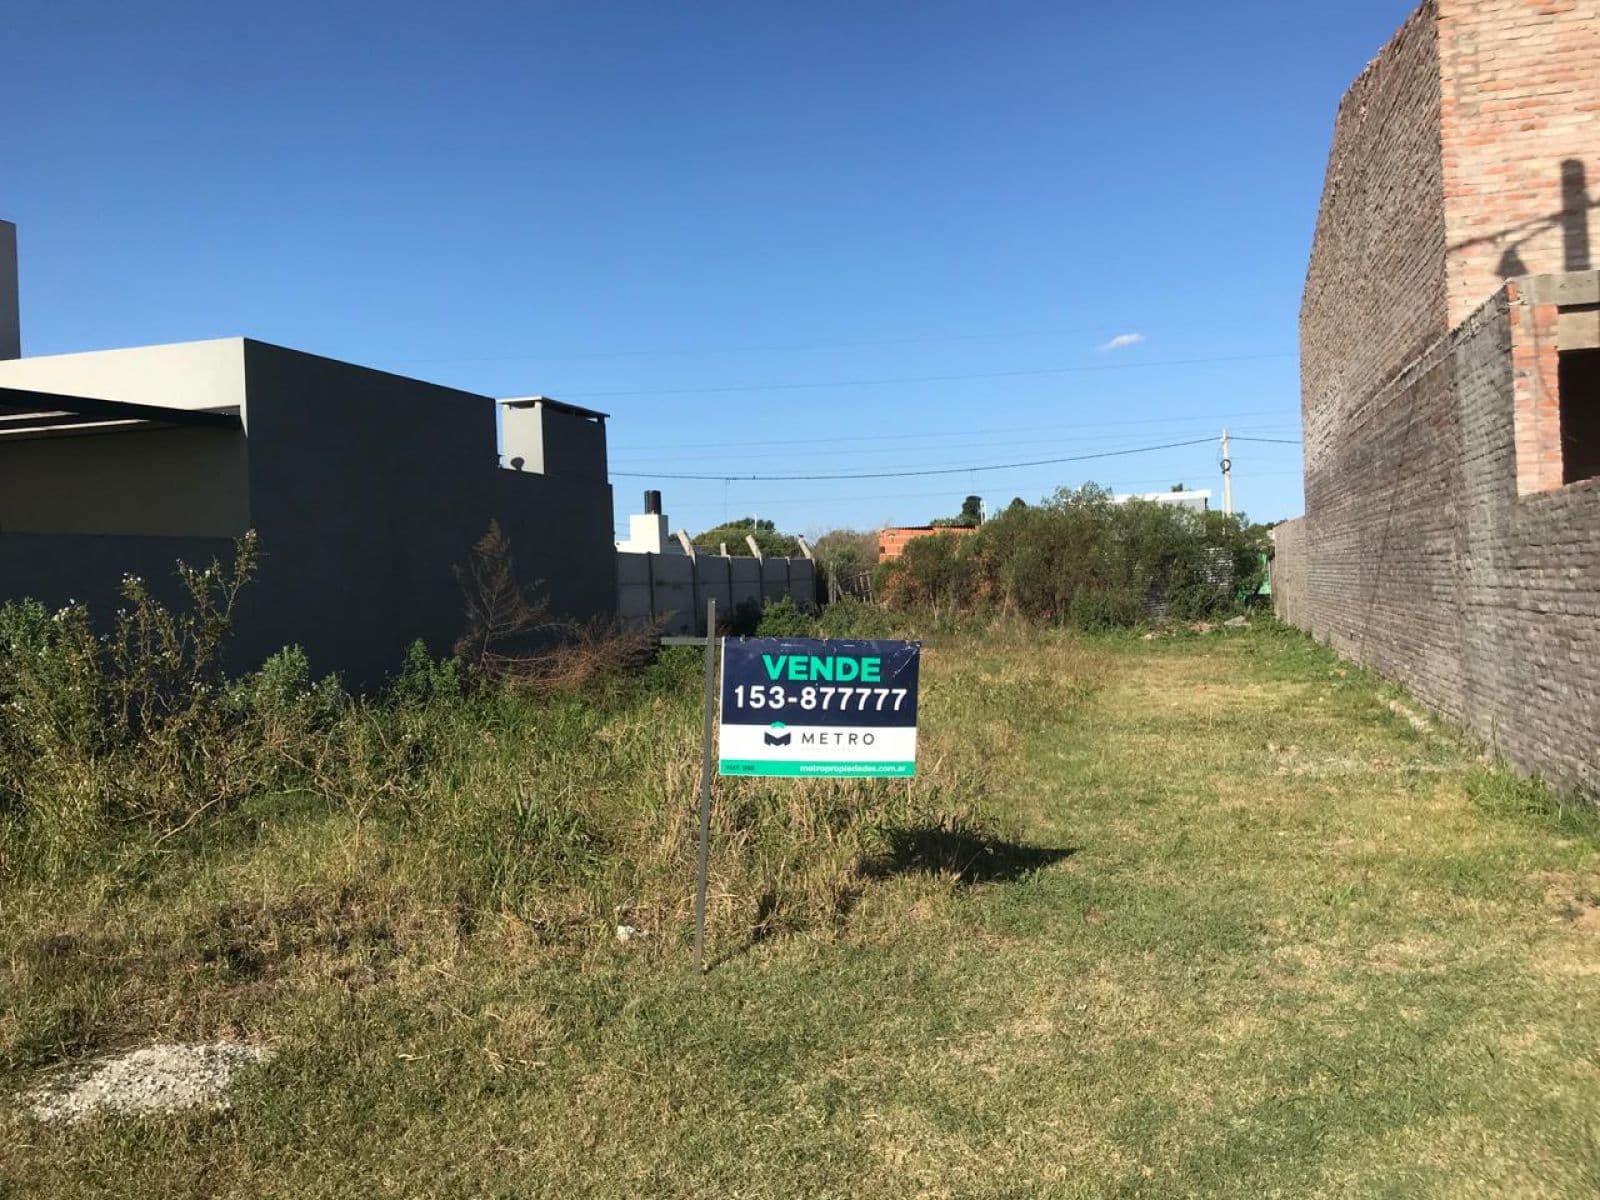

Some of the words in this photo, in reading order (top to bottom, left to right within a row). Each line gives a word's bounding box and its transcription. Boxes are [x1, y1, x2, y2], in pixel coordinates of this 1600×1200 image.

[762, 655, 881, 682] VENDE
[735, 685, 907, 711] 153-877777
[801, 732, 875, 746] METRO
[800, 764, 906, 775] metropropiedades.com.ar
